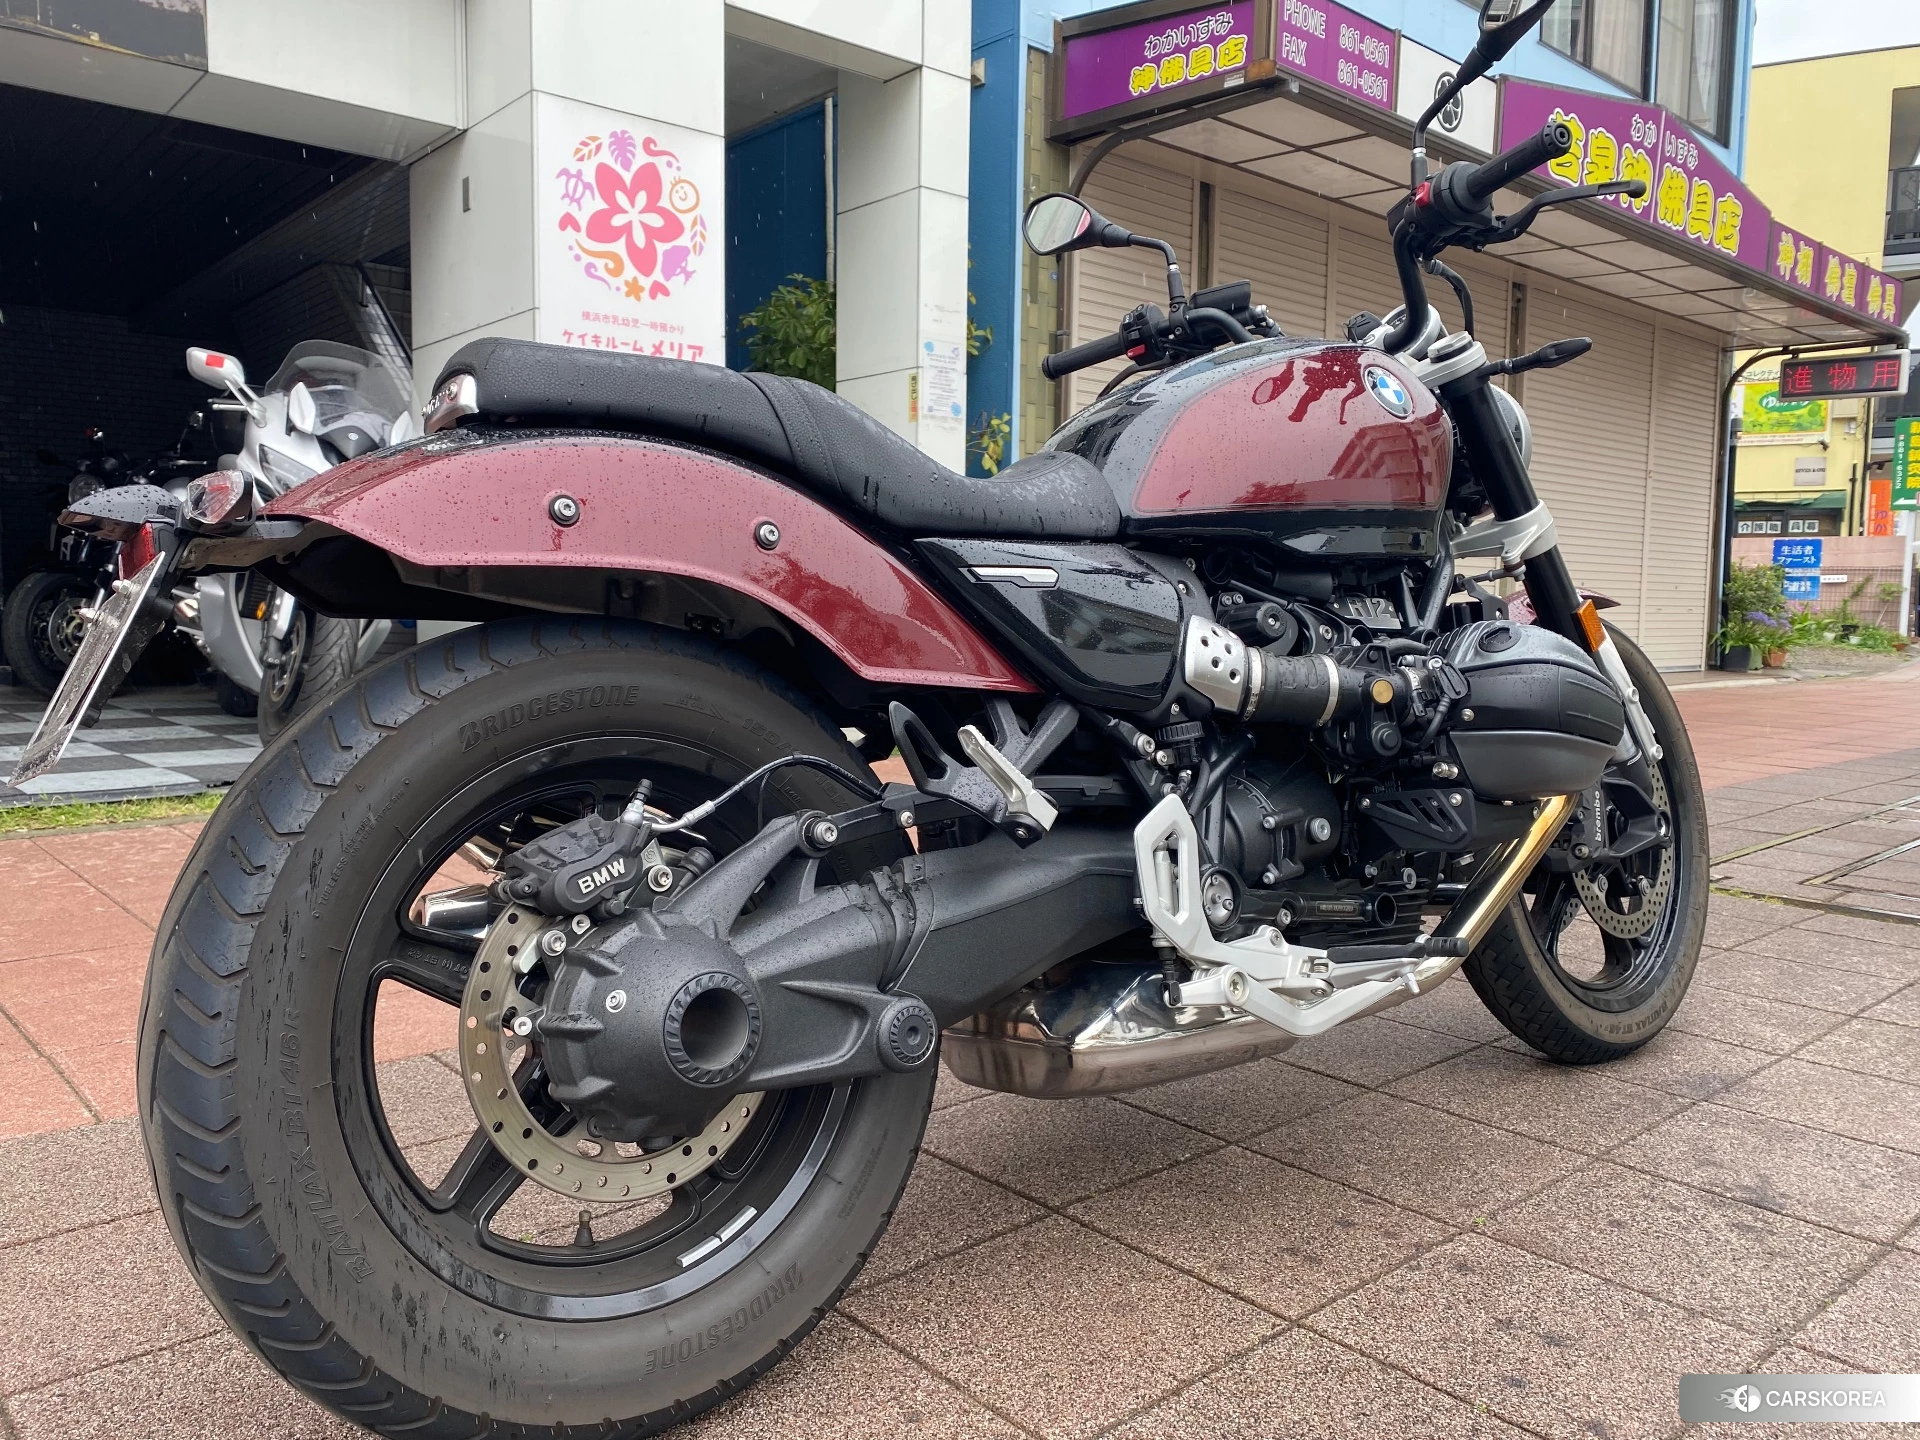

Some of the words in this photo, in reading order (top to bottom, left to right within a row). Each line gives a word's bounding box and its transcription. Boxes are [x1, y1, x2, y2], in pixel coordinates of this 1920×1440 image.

[1144, 11, 1234, 58] わかいずみ
[1284, 0, 1327, 39] PHONE
[1339, 23, 1390, 68] 861-0561
[1282, 32, 1307, 67] FAX
[1337, 58, 1388, 102] 861-0561
[1785, 359, 1901, 394] 進物用
[1776, 555, 1817, 565] ファースト
[1781, 545, 1814, 555] 生活者
[457, 684, 640, 753] BRIDGESTONE
[318, 856, 348, 907] TUBELESS
[577, 857, 627, 894] BMW
[643, 1261, 804, 1377] BRIDGESTONE
